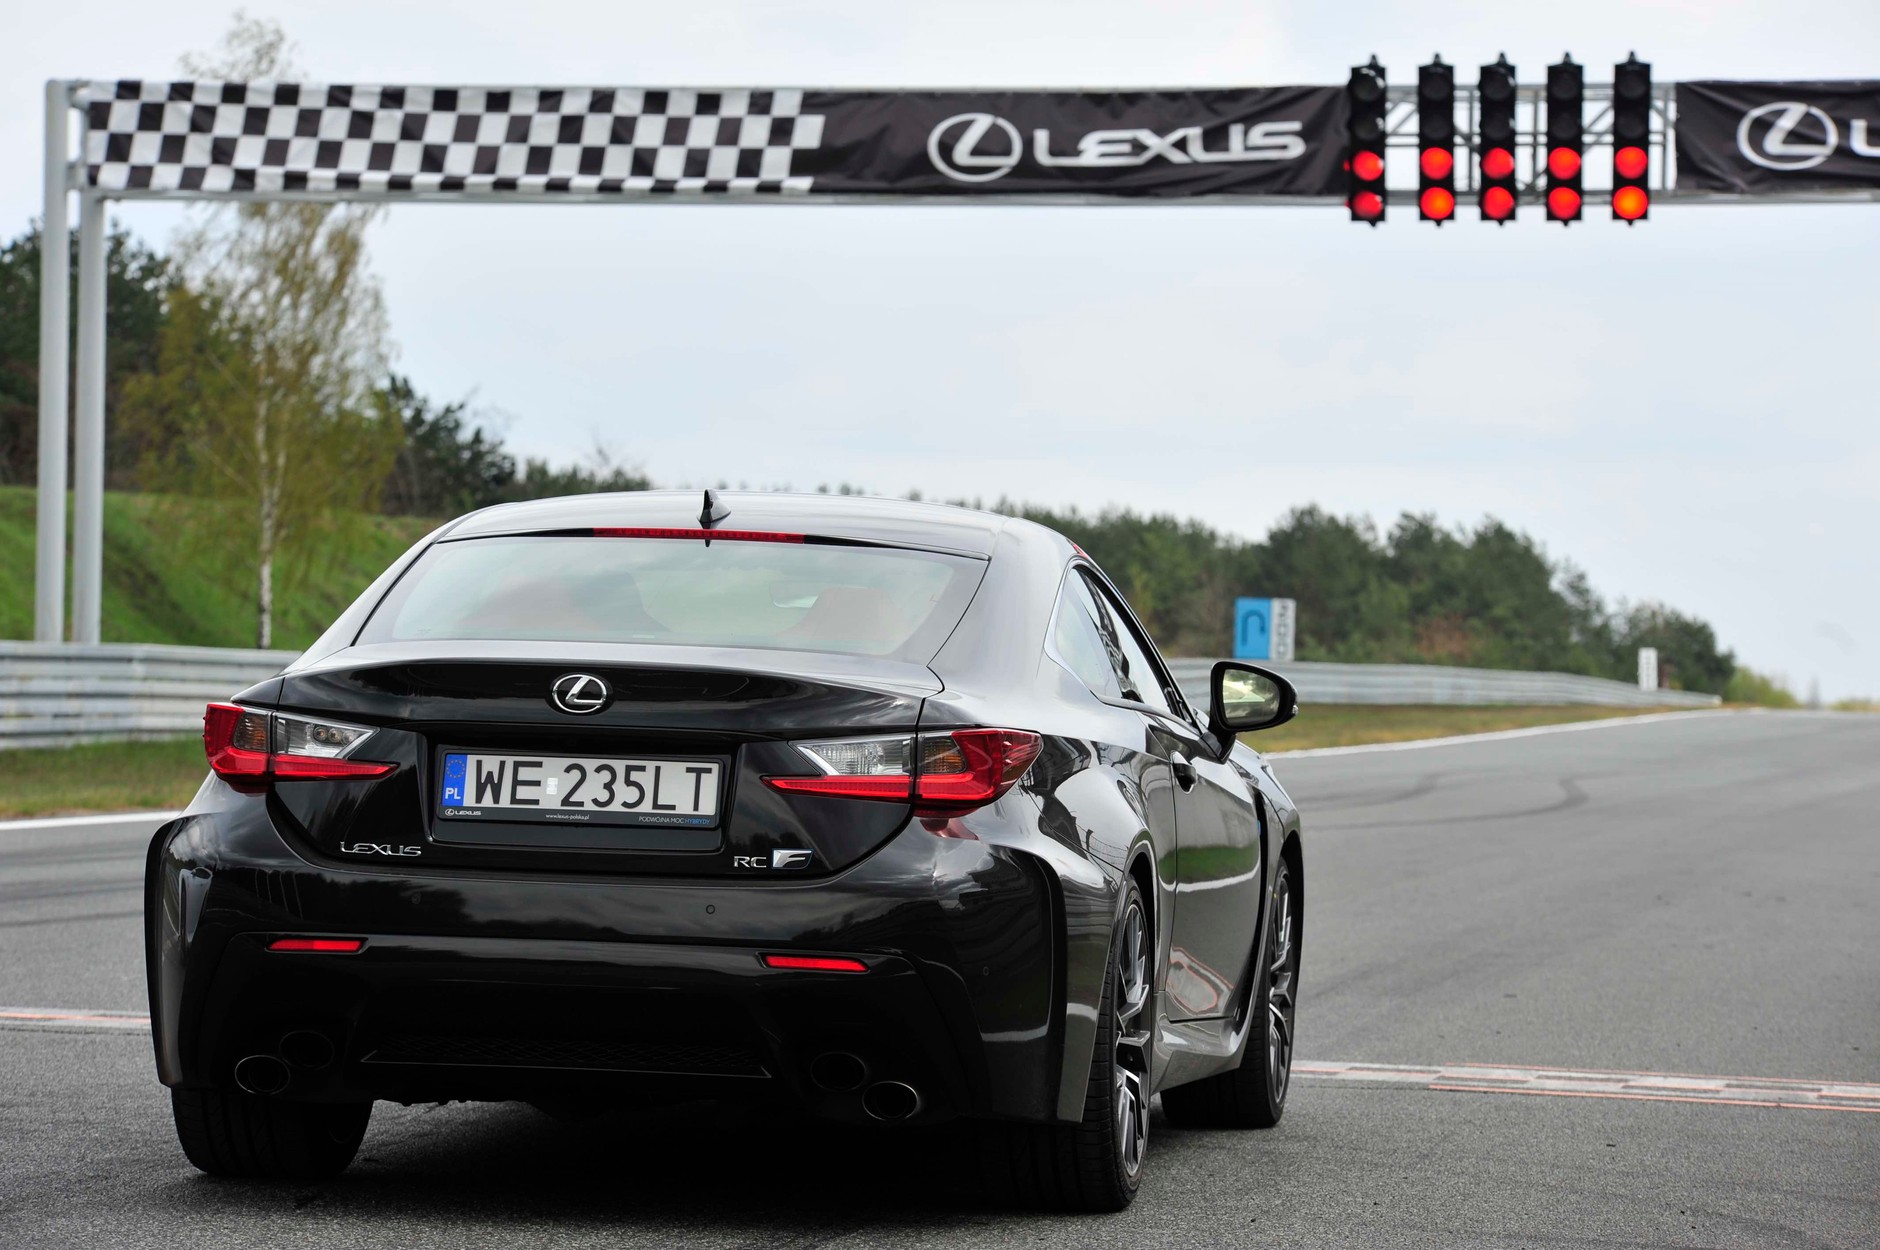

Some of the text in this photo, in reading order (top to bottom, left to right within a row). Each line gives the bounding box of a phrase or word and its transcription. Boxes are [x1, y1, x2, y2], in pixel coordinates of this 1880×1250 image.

[1033, 120, 1307, 167] LEXUS
[444, 787, 461, 800] PL
[475, 759, 713, 812] WE 235LT
[340, 841, 422, 857] LEXUS
[733, 848, 813, 869] RC F
